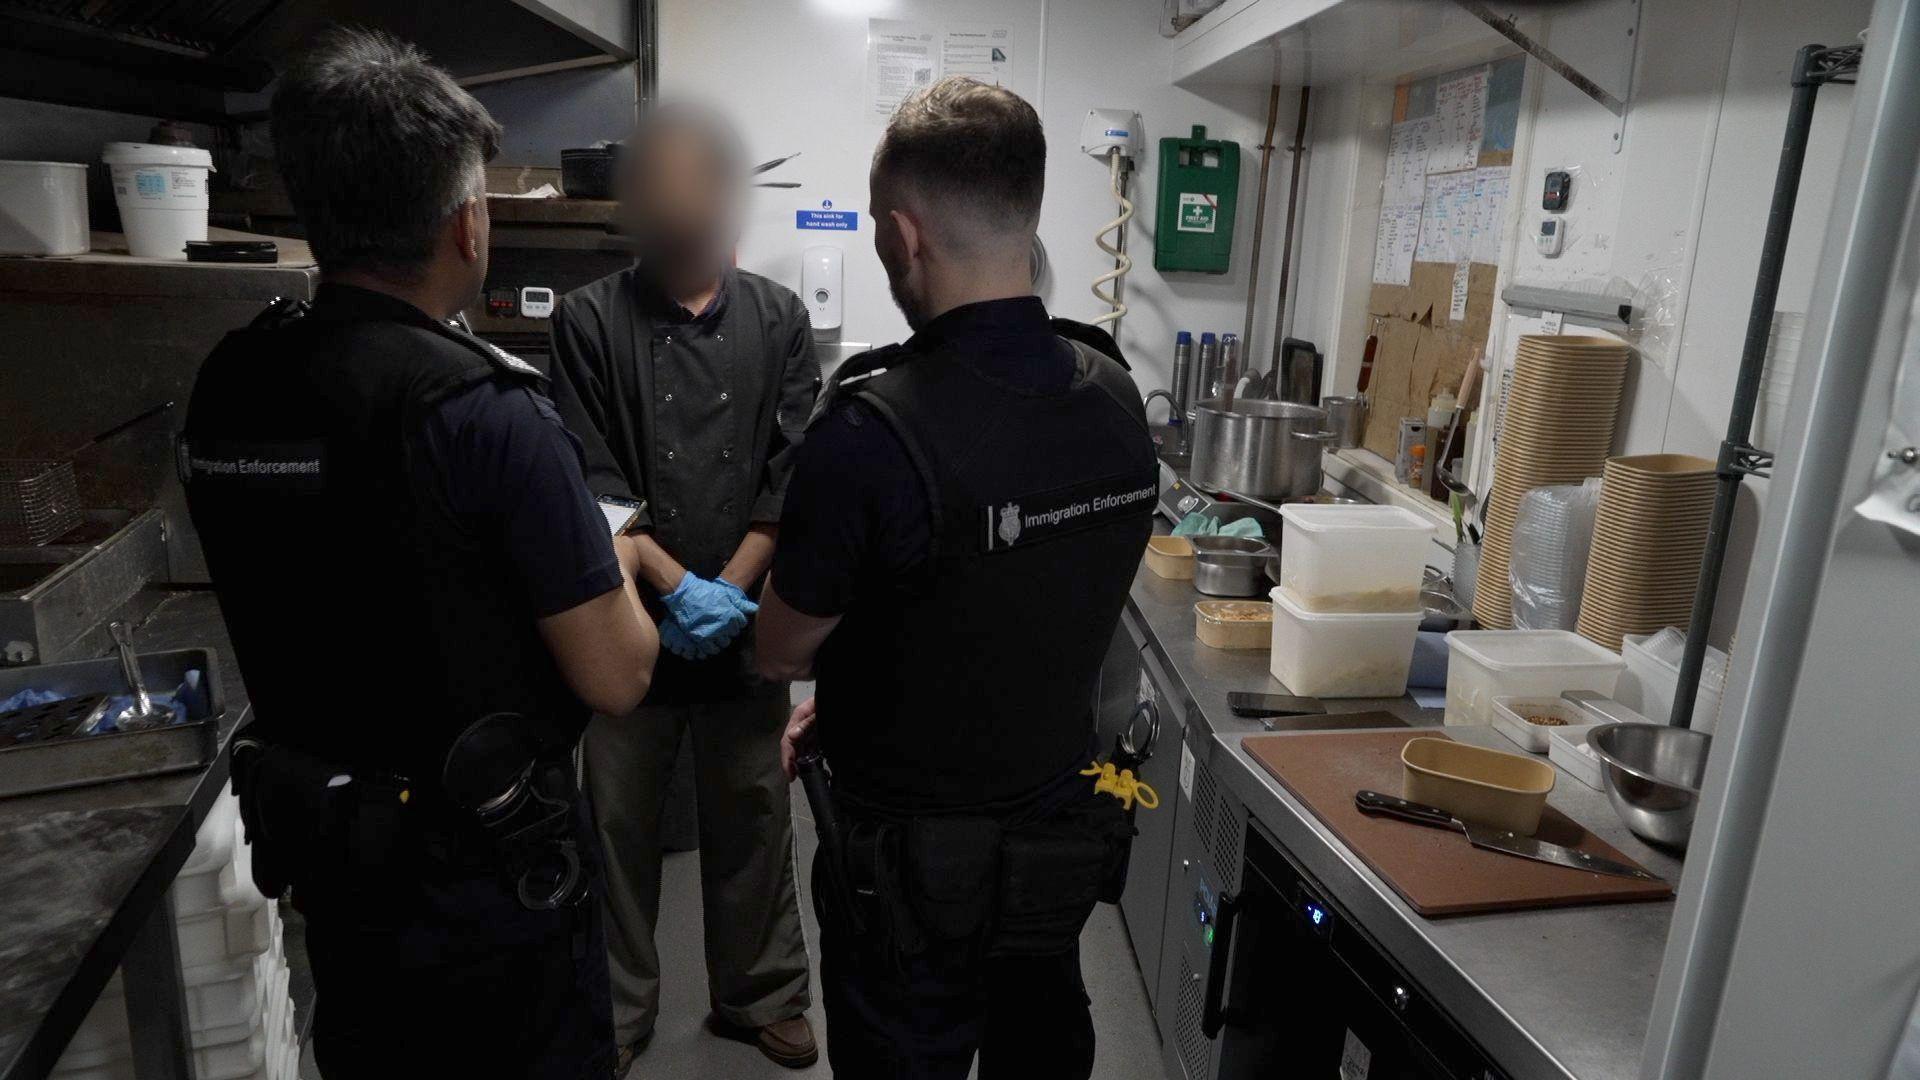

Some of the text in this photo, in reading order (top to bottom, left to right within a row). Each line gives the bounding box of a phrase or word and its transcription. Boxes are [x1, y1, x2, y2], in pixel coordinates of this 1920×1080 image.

[239, 459, 321, 474] Enforcement
[1025, 484, 1156, 528] Immigration Enforcement
